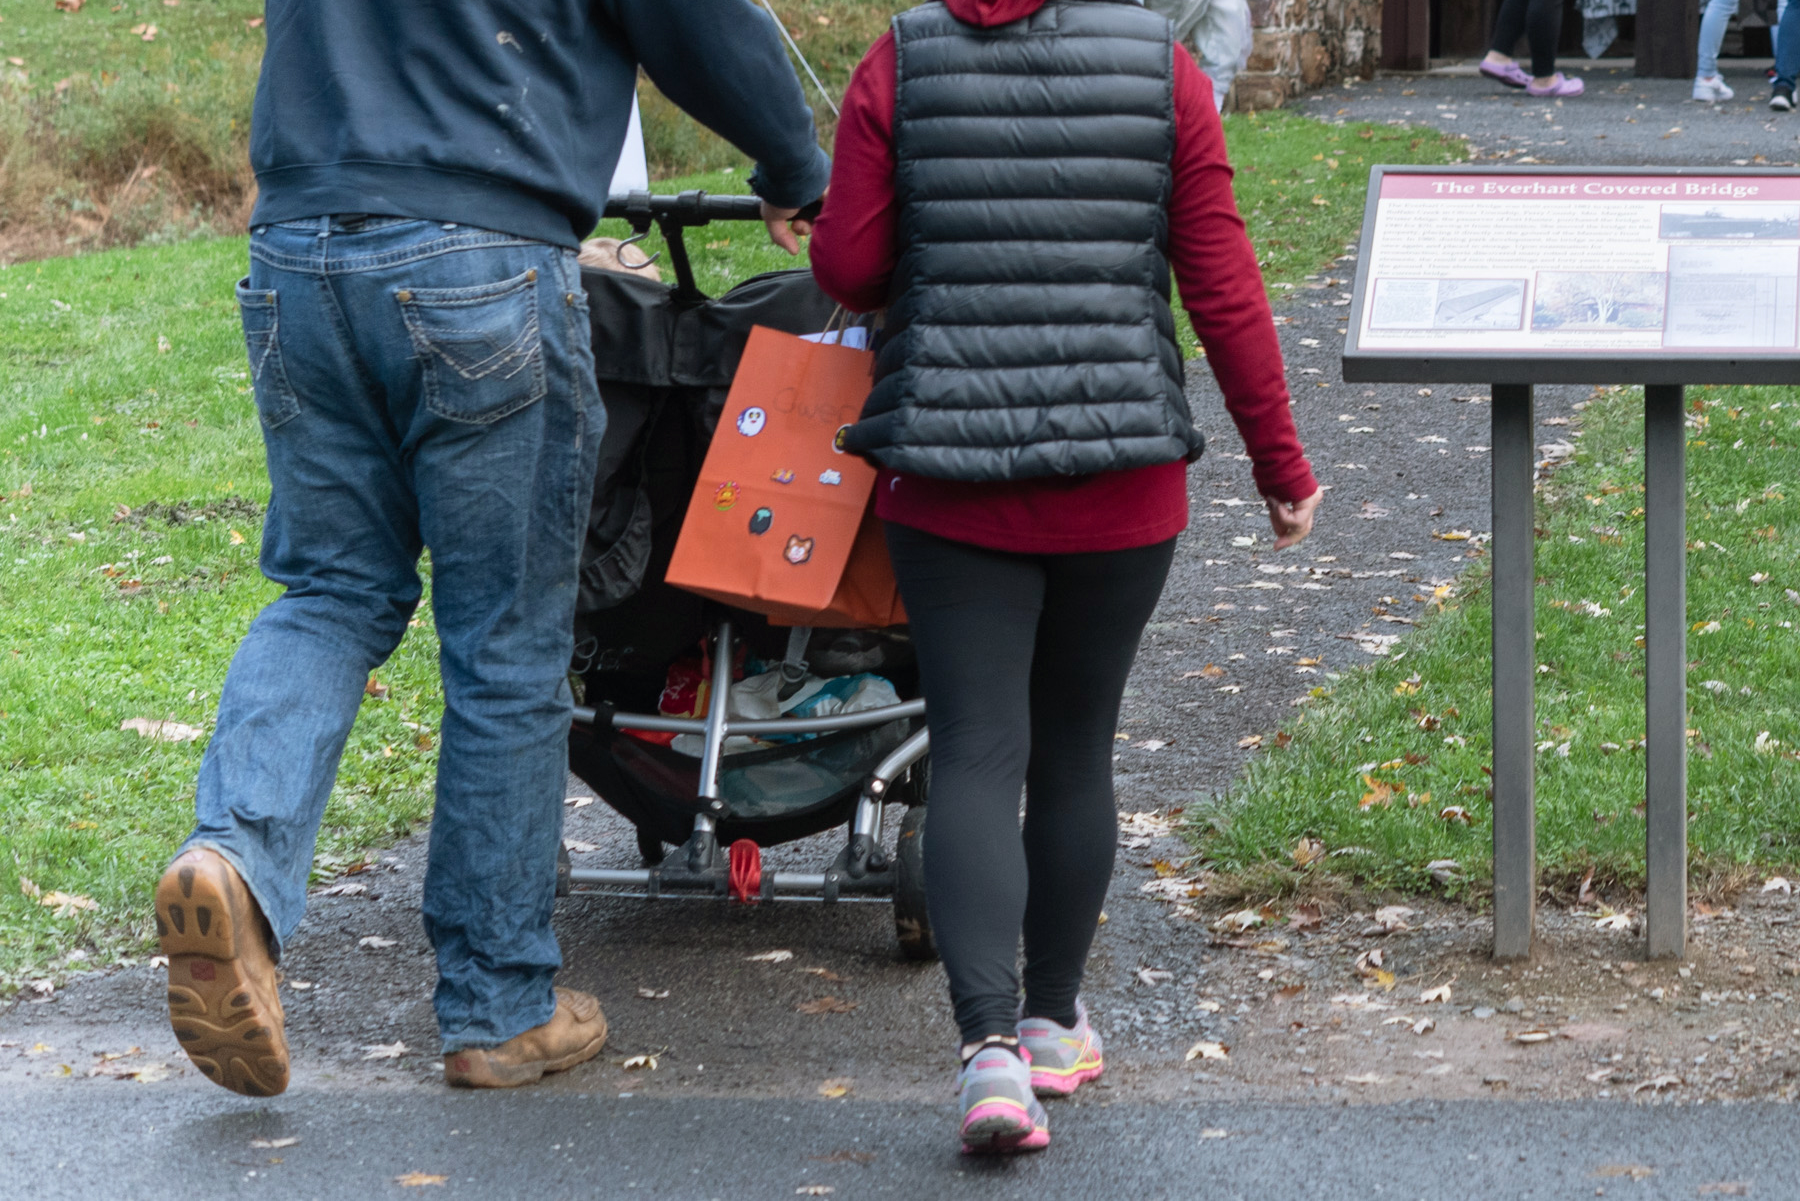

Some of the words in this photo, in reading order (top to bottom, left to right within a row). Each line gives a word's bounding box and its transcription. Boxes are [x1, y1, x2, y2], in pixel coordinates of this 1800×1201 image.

[1431, 181, 1476, 195] The
[1482, 181, 1577, 195] Everhart
[1583, 181, 1677, 196] Covered
[1684, 182, 1760, 198] Bridge
